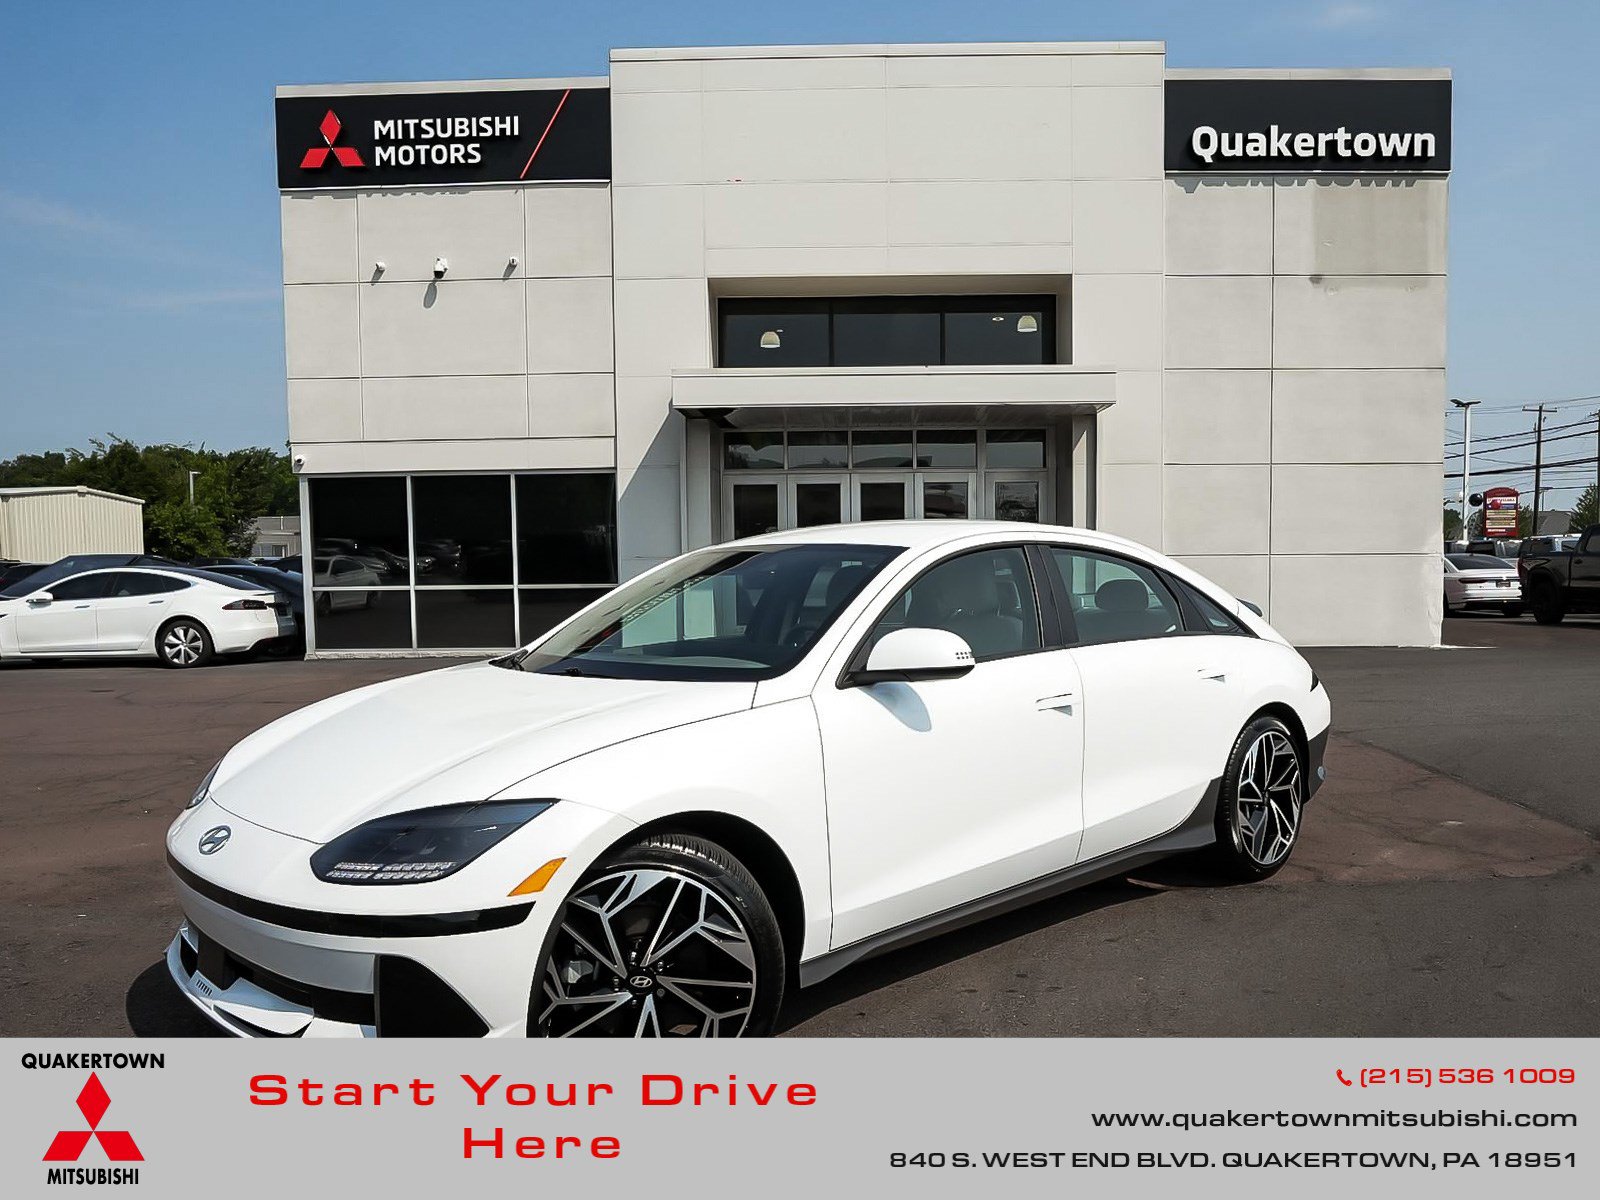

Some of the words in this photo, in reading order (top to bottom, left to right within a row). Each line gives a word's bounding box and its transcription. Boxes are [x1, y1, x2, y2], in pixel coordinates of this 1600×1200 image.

[373, 115, 519, 140] MITSUBISHI
[374, 143, 482, 167] MOTORS
[1192, 124, 1436, 163] Quakertown
